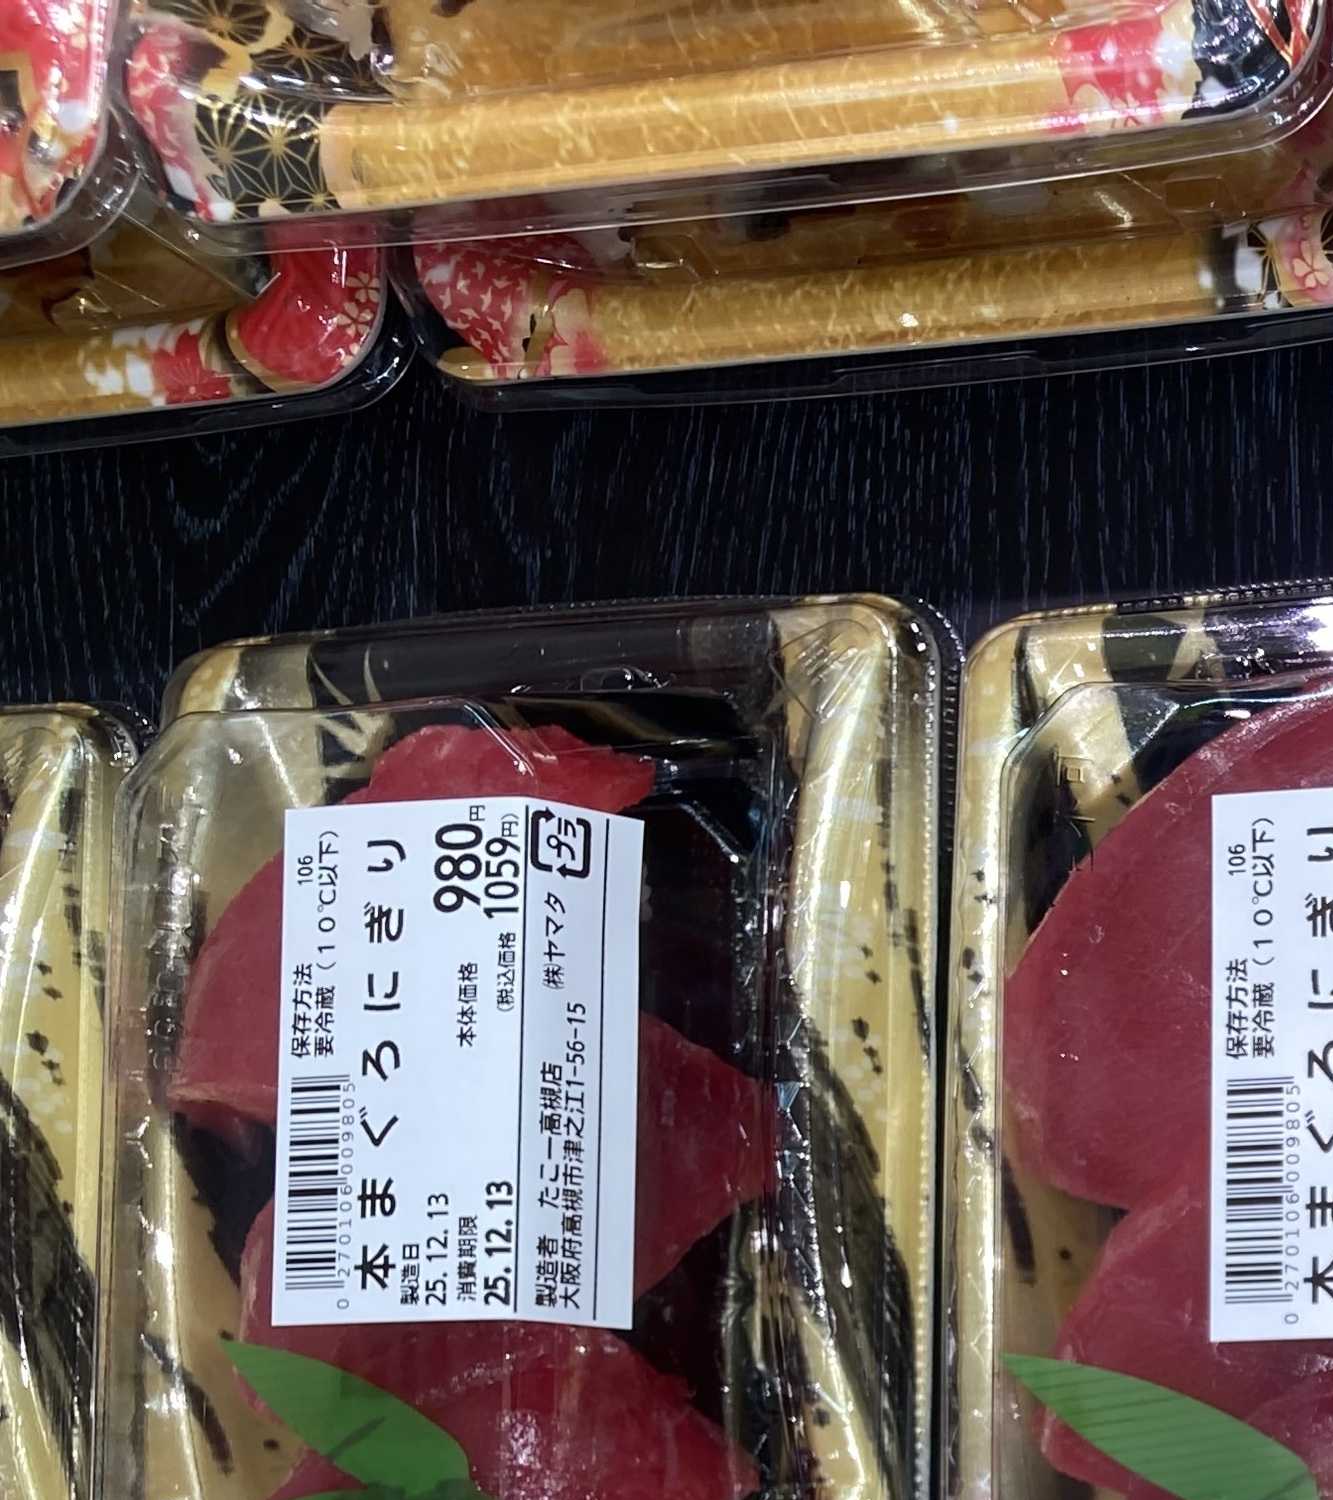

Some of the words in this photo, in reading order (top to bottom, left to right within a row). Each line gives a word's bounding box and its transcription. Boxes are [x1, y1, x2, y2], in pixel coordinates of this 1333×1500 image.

[297, 856, 313, 886] 106
[1228, 844, 1245, 876] 106
[292, 963, 312, 1058] 保存方法
[457, 962, 477, 1047] 本体価格
[1226, 959, 1248, 1059] 保存方法
[354, 838, 405, 1290] 本まぐろにぎり
[401, 1243, 419, 1306] 製造日
[427, 1193, 448, 1306] 25.12.13
[457, 1215, 477, 1302] 消費期限
[485, 1181, 513, 1306] 25.12.13
[536, 1235, 559, 1308] 製造者
